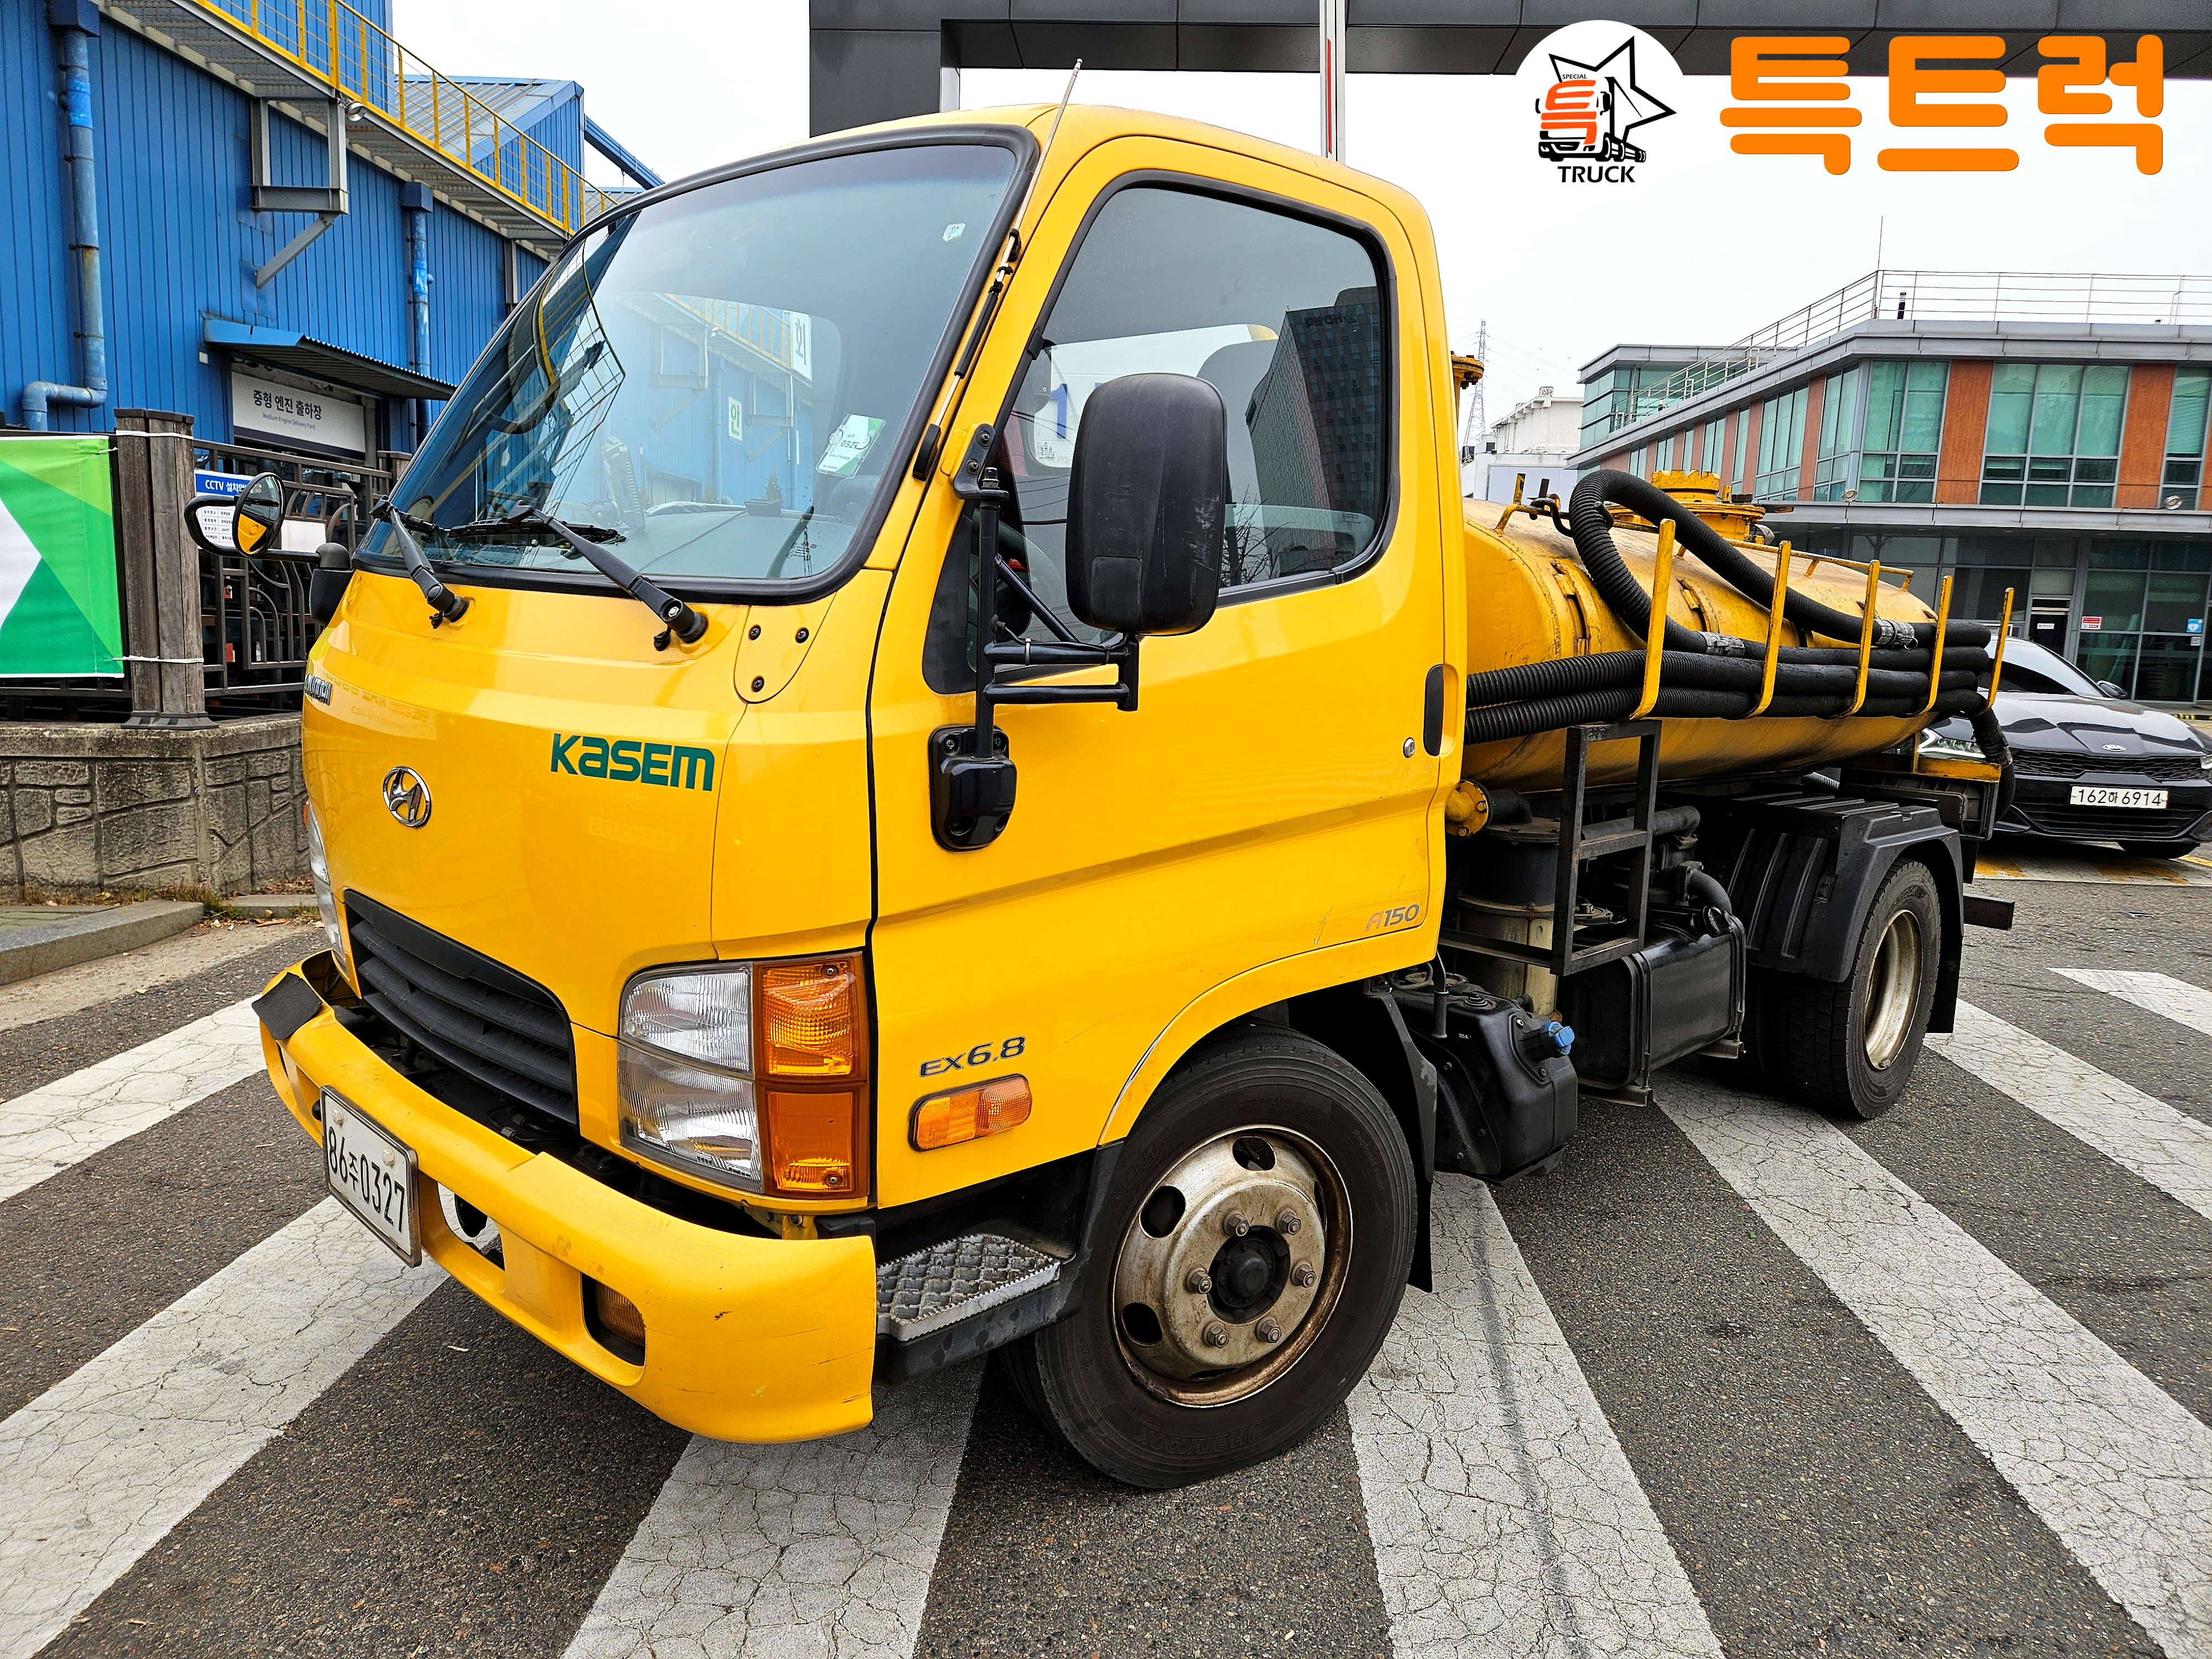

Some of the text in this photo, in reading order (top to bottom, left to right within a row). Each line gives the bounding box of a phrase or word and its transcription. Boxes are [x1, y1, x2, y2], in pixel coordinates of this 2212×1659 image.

[253, 389, 322, 420] 중형 엔진 출하장
[731, 403, 740, 436] 안
[205, 479, 247, 493] CCTV 설치안
[2079, 789, 2162, 806] 162하6914
[1365, 904, 1420, 932] A150
[919, 1035, 1026, 1077] EX6.8
[1351, 1128, 1378, 1167] Regional
[328, 1126, 405, 1233] 86주0327
